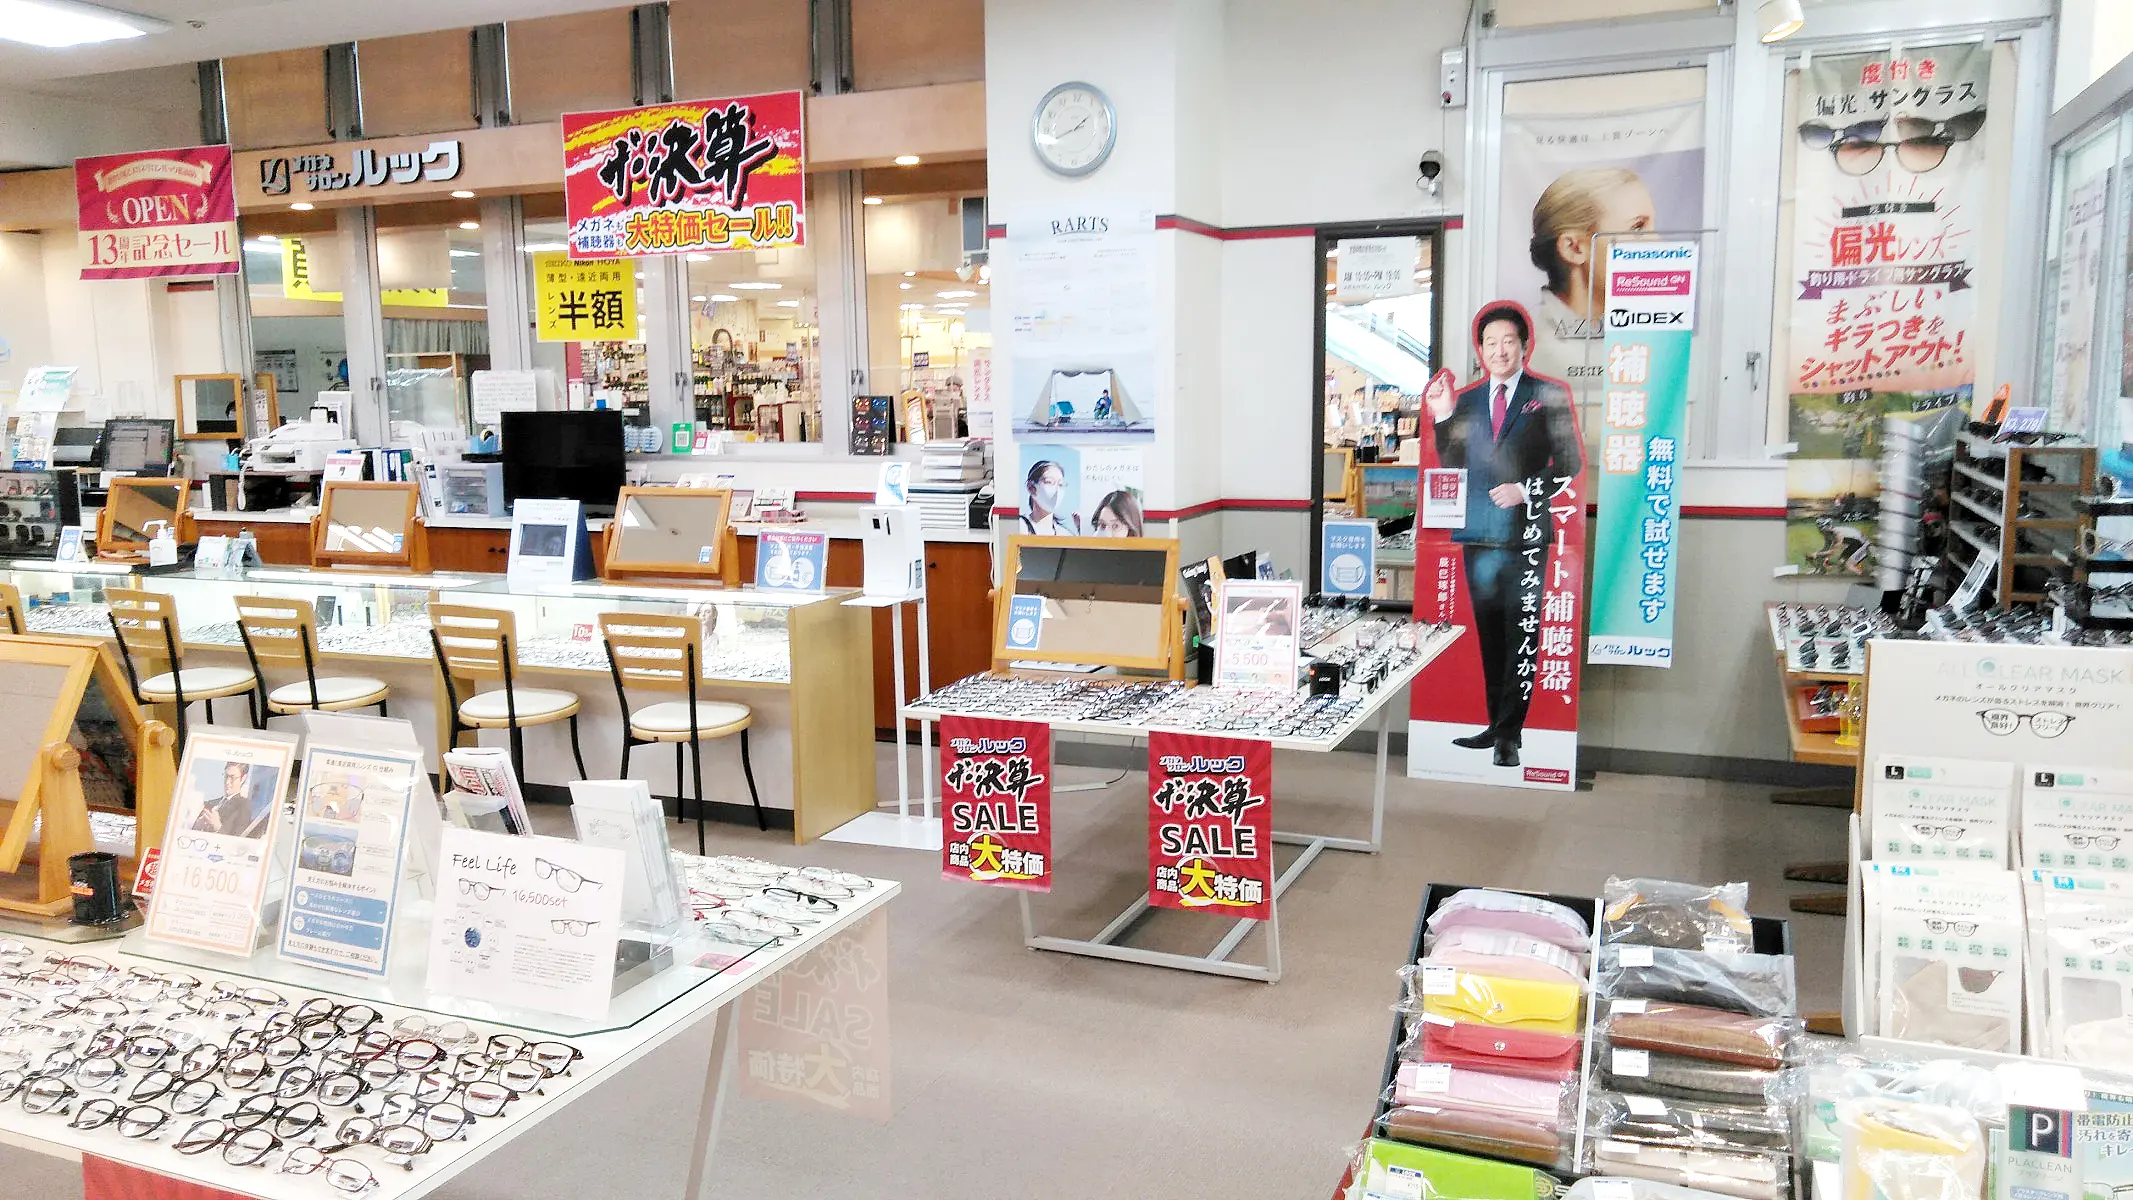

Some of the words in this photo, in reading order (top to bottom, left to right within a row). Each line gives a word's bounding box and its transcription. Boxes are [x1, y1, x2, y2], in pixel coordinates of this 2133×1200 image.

[1861, 57, 1936, 85] 度付き
[1869, 80, 1977, 110] サングラス
[350, 140, 461, 187] ルック
[122, 194, 190, 225] OPEN
[577, 219, 624, 232] メガネも
[1052, 215, 1109, 235] RARTS
[1612, 246, 1692, 261] Panasonic
[1830, 222, 1945, 267] 偏光レンズ
[1616, 274, 1668, 289] ReSound
[547, 292, 557, 329] レンズ
[558, 289, 625, 331] 半額
[1610, 308, 1685, 328] WIDEX
[1826, 287, 1943, 325] まぶしい
[1824, 314, 1945, 353] ギラつきを
[1604, 344, 1649, 472] 補聴器
[1640, 436, 1675, 621] 無料で試せます
[1517, 477, 1545, 701] はじめてみませんか？
[1539, 475, 1577, 704] スマート補聴器、
[1975, 683, 2078, 695] オールクリアマスク
[2061, 667, 2125, 685] MASK
[979, 737, 1027, 753] ルック
[1190, 756, 1245, 773] ルック
[953, 803, 1038, 832] SALE
[949, 842, 969, 855] 店内
[971, 834, 1044, 876] 大特価
[1161, 825, 1256, 857] SALE
[452, 853, 481, 870] Feel
[486, 856, 517, 880] Life
[949, 854, 969, 868] 商品
[1156, 866, 1178, 879] 店内
[1156, 878, 1178, 893] 商品
[1179, 858, 1264, 903] 大特価
[2031, 1112, 2055, 1148] P
[2077, 1112, 2133, 1127] 帯電防止
[2007, 1157, 2073, 1174] PLACLEAN
